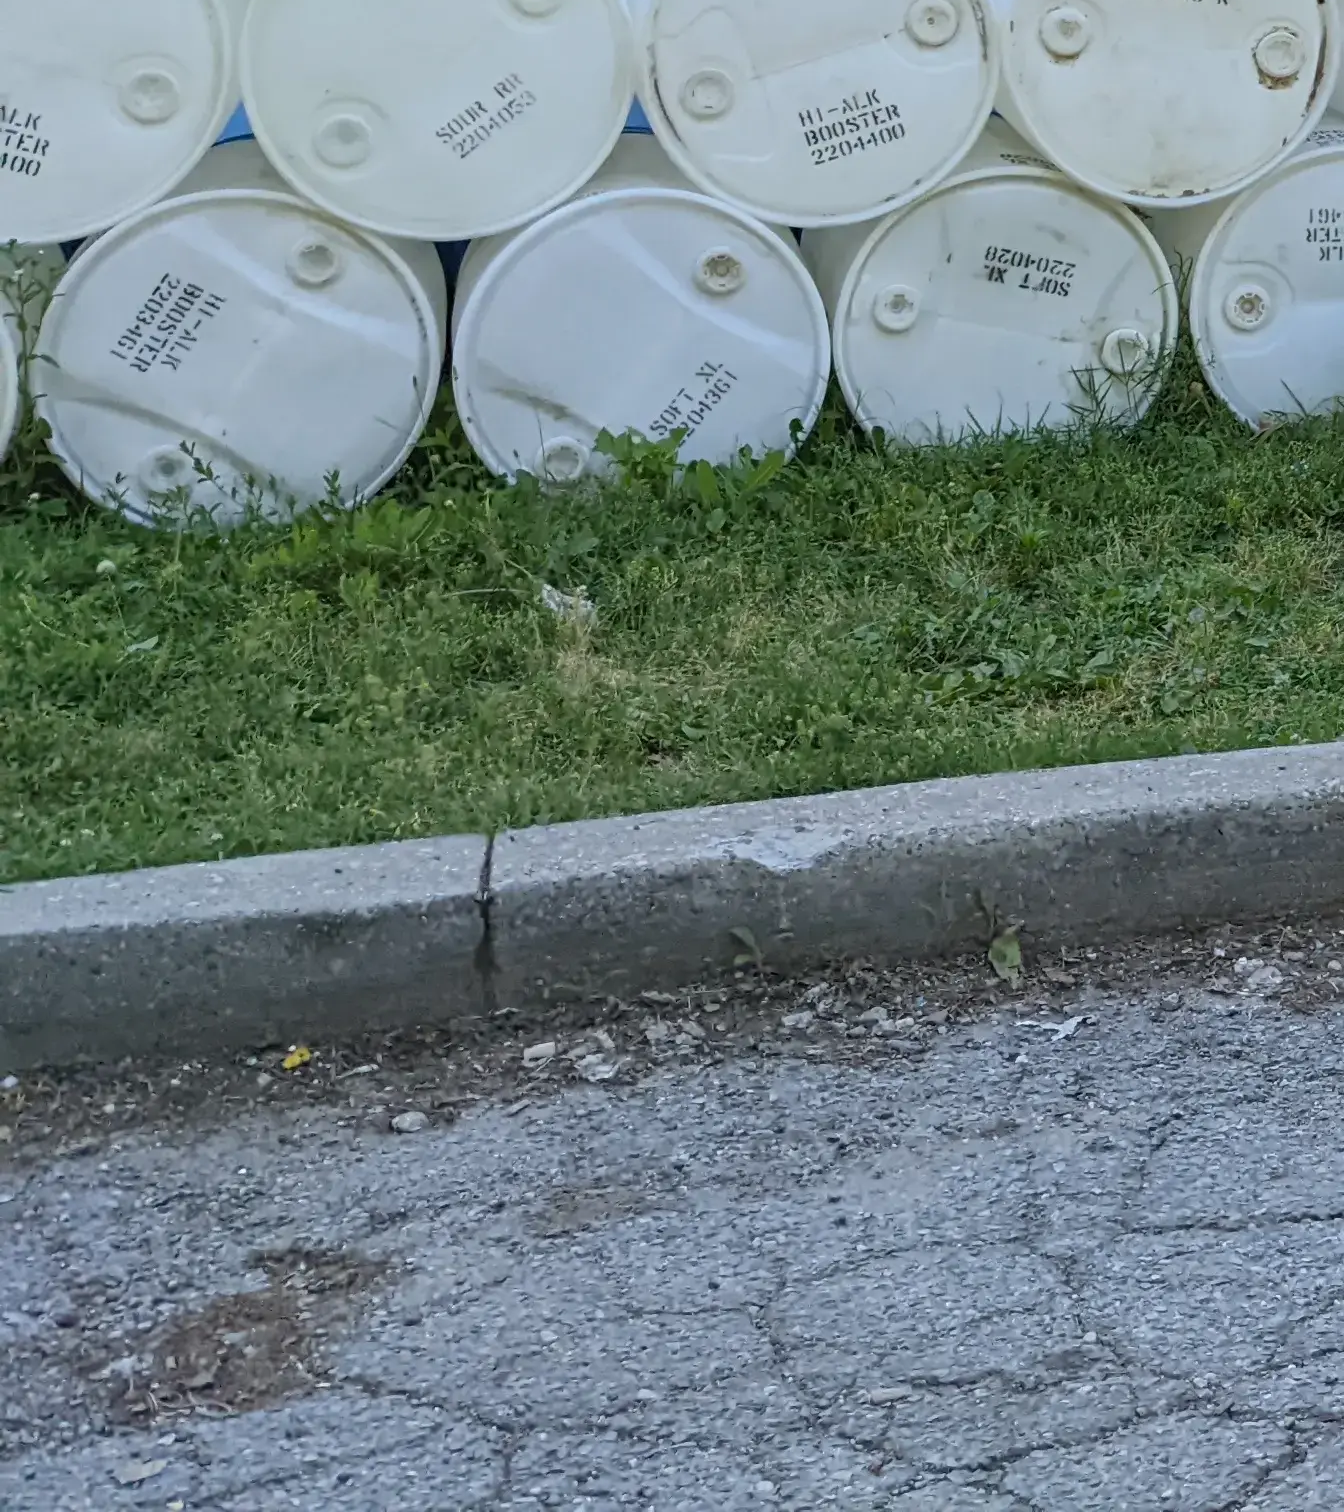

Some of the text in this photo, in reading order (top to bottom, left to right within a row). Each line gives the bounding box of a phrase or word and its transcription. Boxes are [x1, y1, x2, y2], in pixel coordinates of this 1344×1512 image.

[435, 101, 488, 144] SOUR
[798, 88, 882, 128] HI-ALK
[804, 102, 902, 147] BOOSTER
[0, 127, 50, 156] TER
[810, 122, 906, 166] 2204400
[982, 262, 1071, 298] SOFT XL
[130, 282, 205, 373] BOOSTER
[162, 295, 227, 372] HI-ALK
[649, 360, 724, 437] SOFT XL
